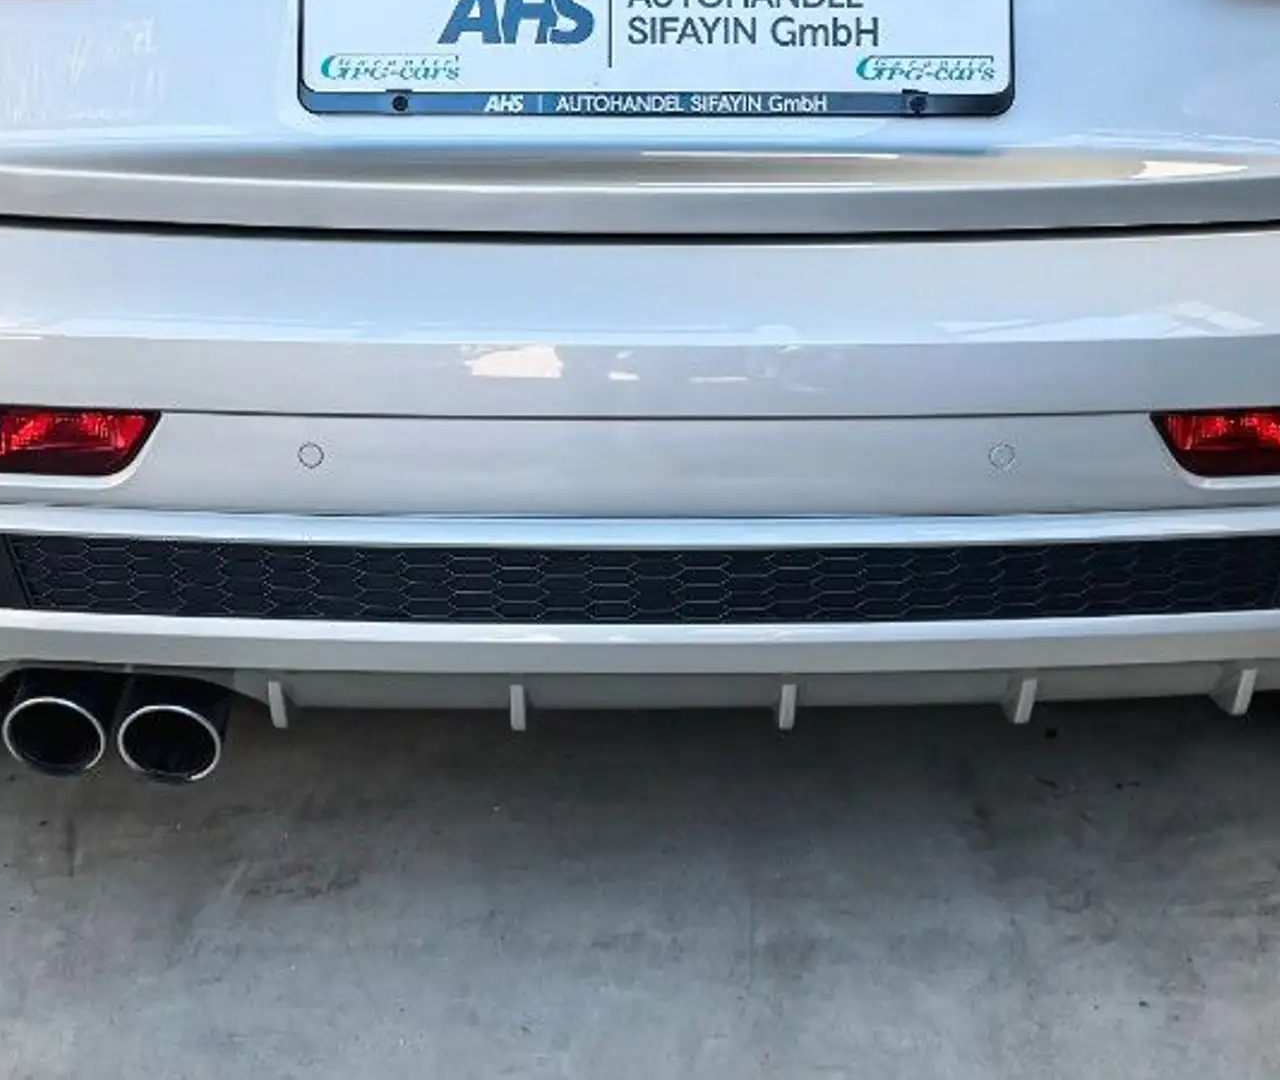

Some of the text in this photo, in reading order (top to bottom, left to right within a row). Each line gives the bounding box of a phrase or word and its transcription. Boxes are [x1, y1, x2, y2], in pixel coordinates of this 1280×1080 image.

[627, 16, 879, 47] SIFAYIN GmbH
[483, 94, 828, 112] AHS AUTOHANDEL SIFAYIN GmbH
